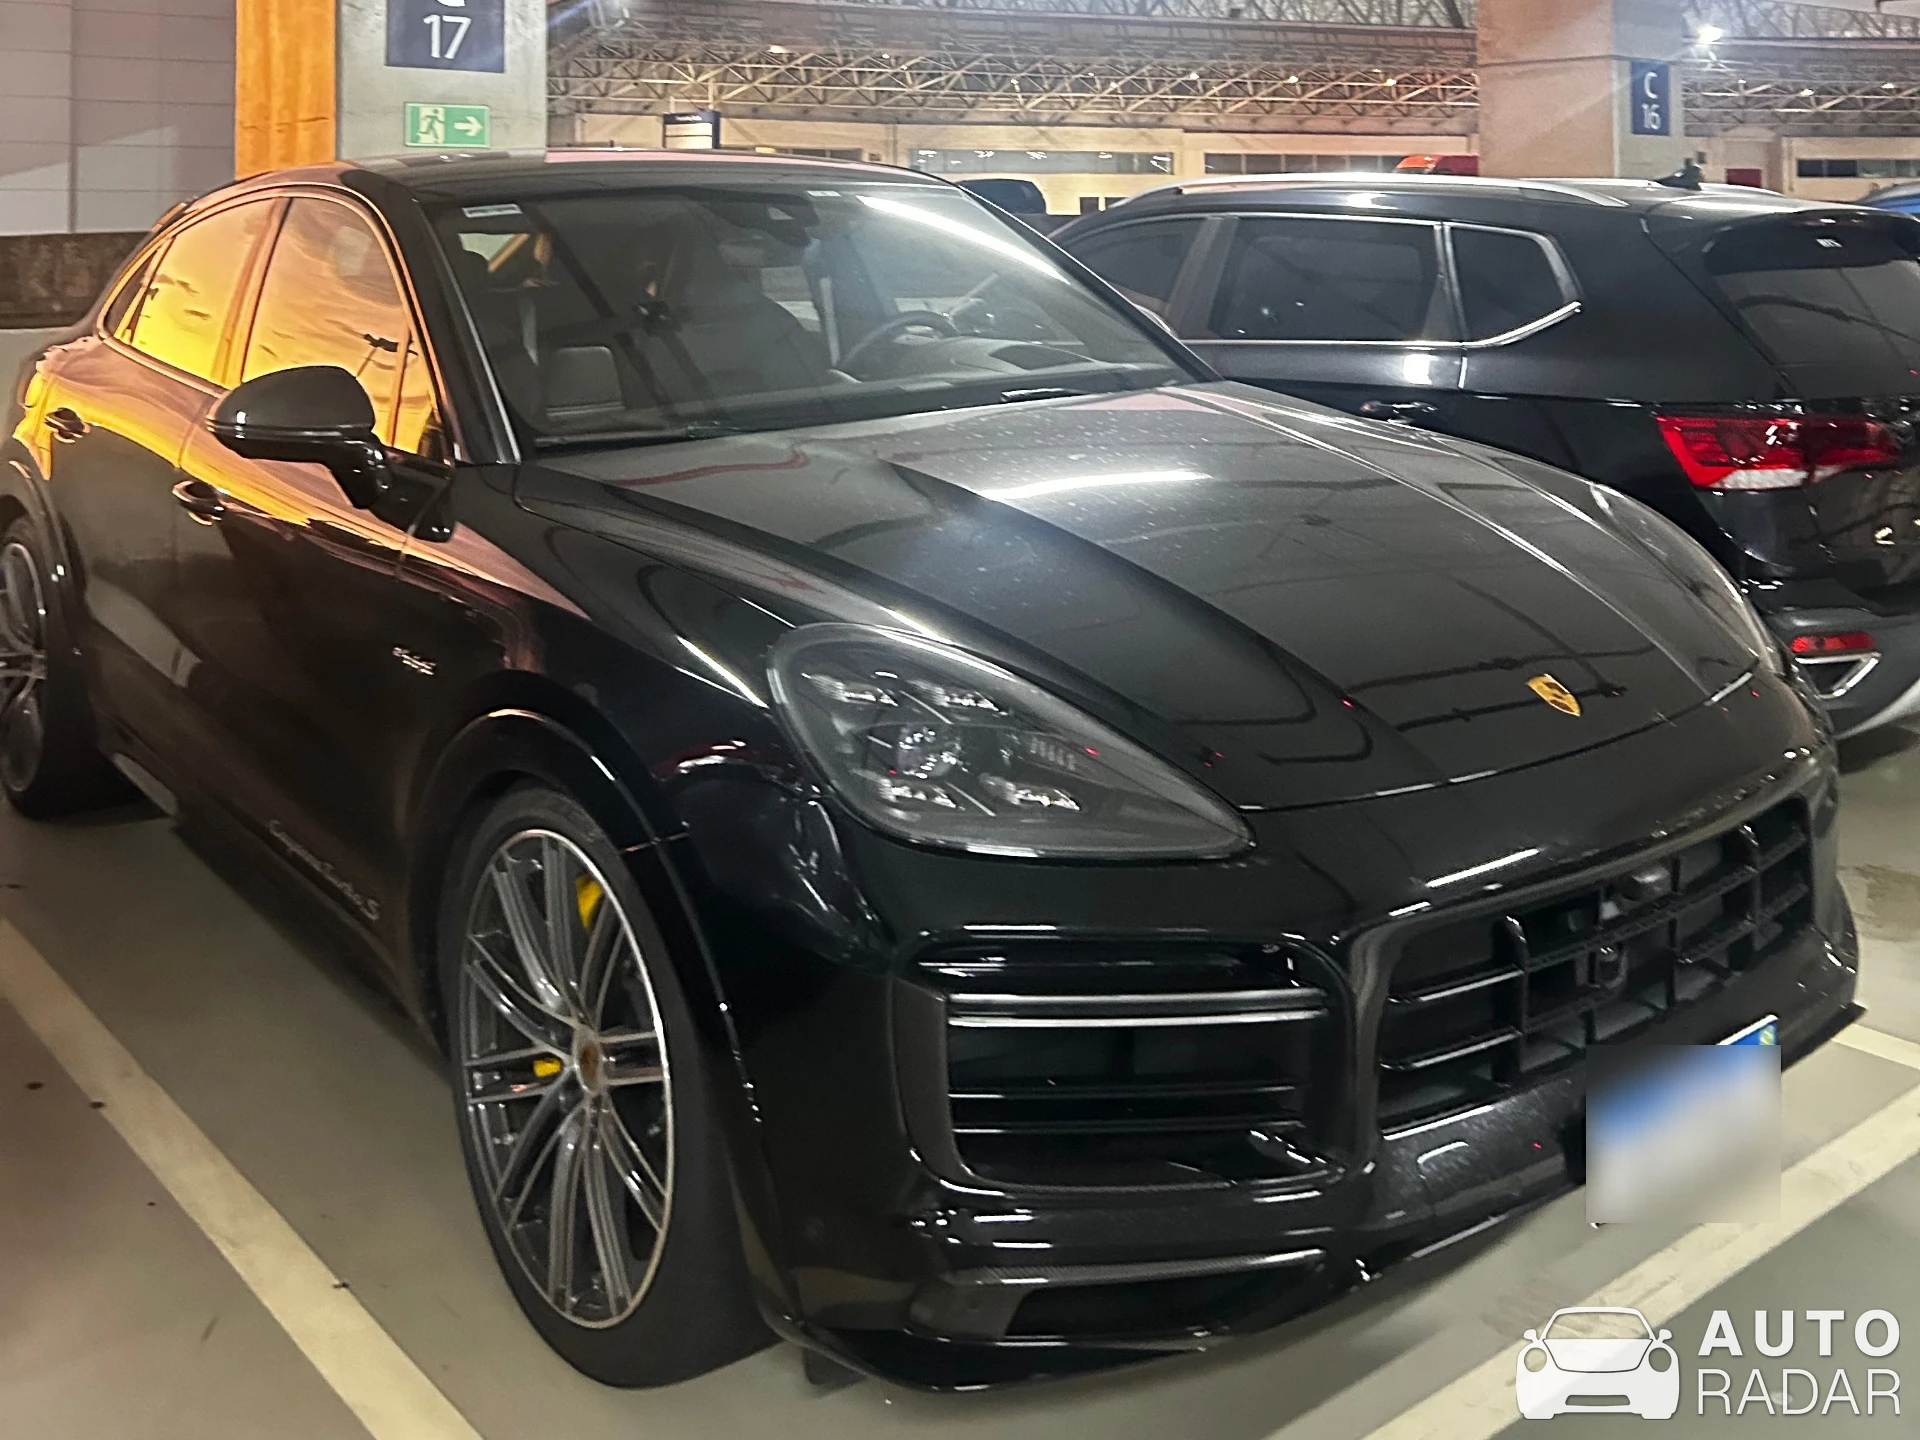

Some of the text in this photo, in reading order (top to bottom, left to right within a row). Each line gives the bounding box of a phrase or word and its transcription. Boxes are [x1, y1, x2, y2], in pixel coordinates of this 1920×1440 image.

[423, 14, 472, 60] 17
[1644, 71, 1659, 99] C
[1641, 102, 1662, 130] 16
